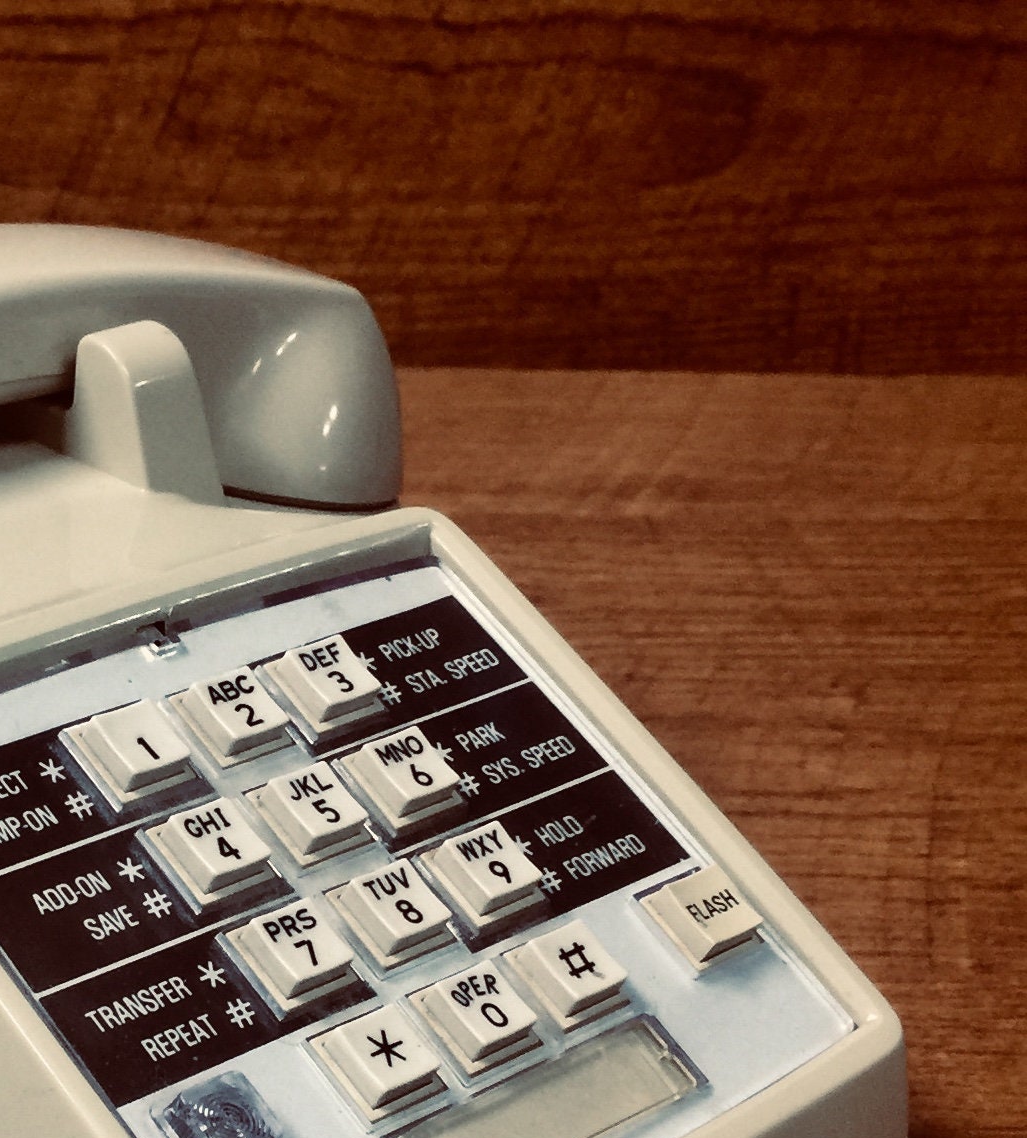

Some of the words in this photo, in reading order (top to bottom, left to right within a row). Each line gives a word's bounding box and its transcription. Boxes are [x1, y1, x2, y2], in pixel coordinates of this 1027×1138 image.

[298, 642, 342, 672] DEF
[379, 628, 440, 662] PICK-UP
[327, 670, 355, 693] 3
[404, 669, 447, 694] STA.
[444, 648, 500, 681] SPEED
[207, 675, 255, 705] ABC
[234, 704, 263, 728] 2
[136, 736, 160, 760] 1
[374, 735, 424, 768] MNO
[455, 722, 506, 753] PARK
[410, 765, 434, 787] 6
[481, 757, 524, 785] SYS.
[521, 735, 577, 770] SPEED
[289, 772, 334, 802] JKL
[183, 808, 231, 838] GHI
[313, 800, 341, 824] 5
[456, 830, 506, 863] WXY
[535, 815, 584, 848] HOLD
[217, 838, 242, 860] 4
[563, 834, 646, 881] FORWARD
[363, 867, 413, 901] TUV
[488, 859, 512, 883] 9
[31, 870, 111, 915] ADD-ON
[685, 889, 741, 924] FLASH
[83, 905, 140, 941] SAVE
[263, 908, 317, 944] PRS
[395, 899, 424, 924] 8
[294, 939, 320, 966] 7
[84, 975, 192, 1033] TRANSFER
[450, 972, 499, 1008] OPER
[141, 1014, 219, 1062] REPEAT
